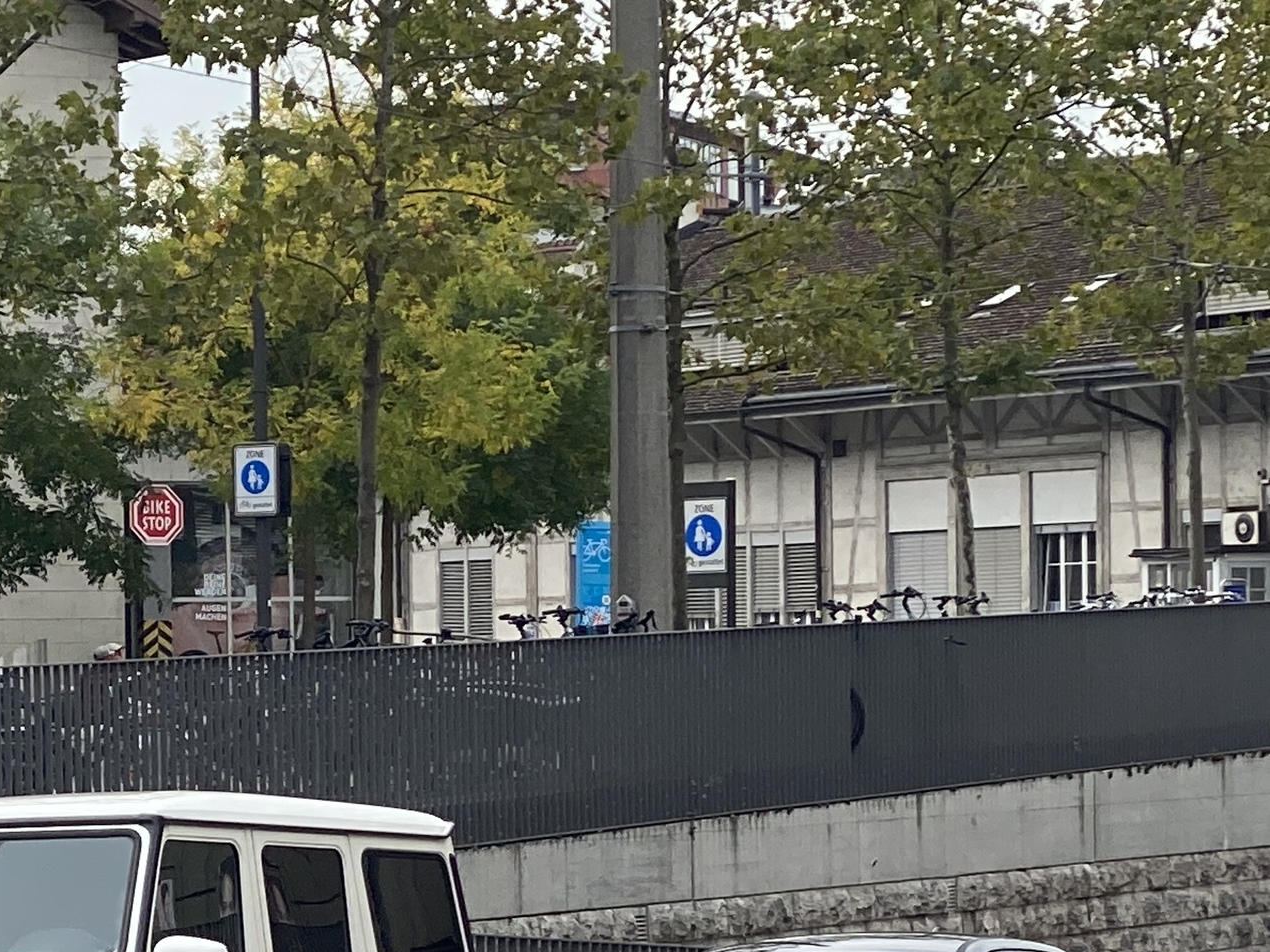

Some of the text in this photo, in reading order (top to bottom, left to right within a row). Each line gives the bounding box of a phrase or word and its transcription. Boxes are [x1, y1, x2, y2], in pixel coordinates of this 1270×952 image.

[246, 450, 265, 459] ZONE
[142, 499, 171, 515] BIKE
[694, 504, 715, 513] ZONE
[142, 516, 172, 531] STOP
[201, 604, 227, 612] AUGEN
[195, 613, 227, 621] MACHEN
